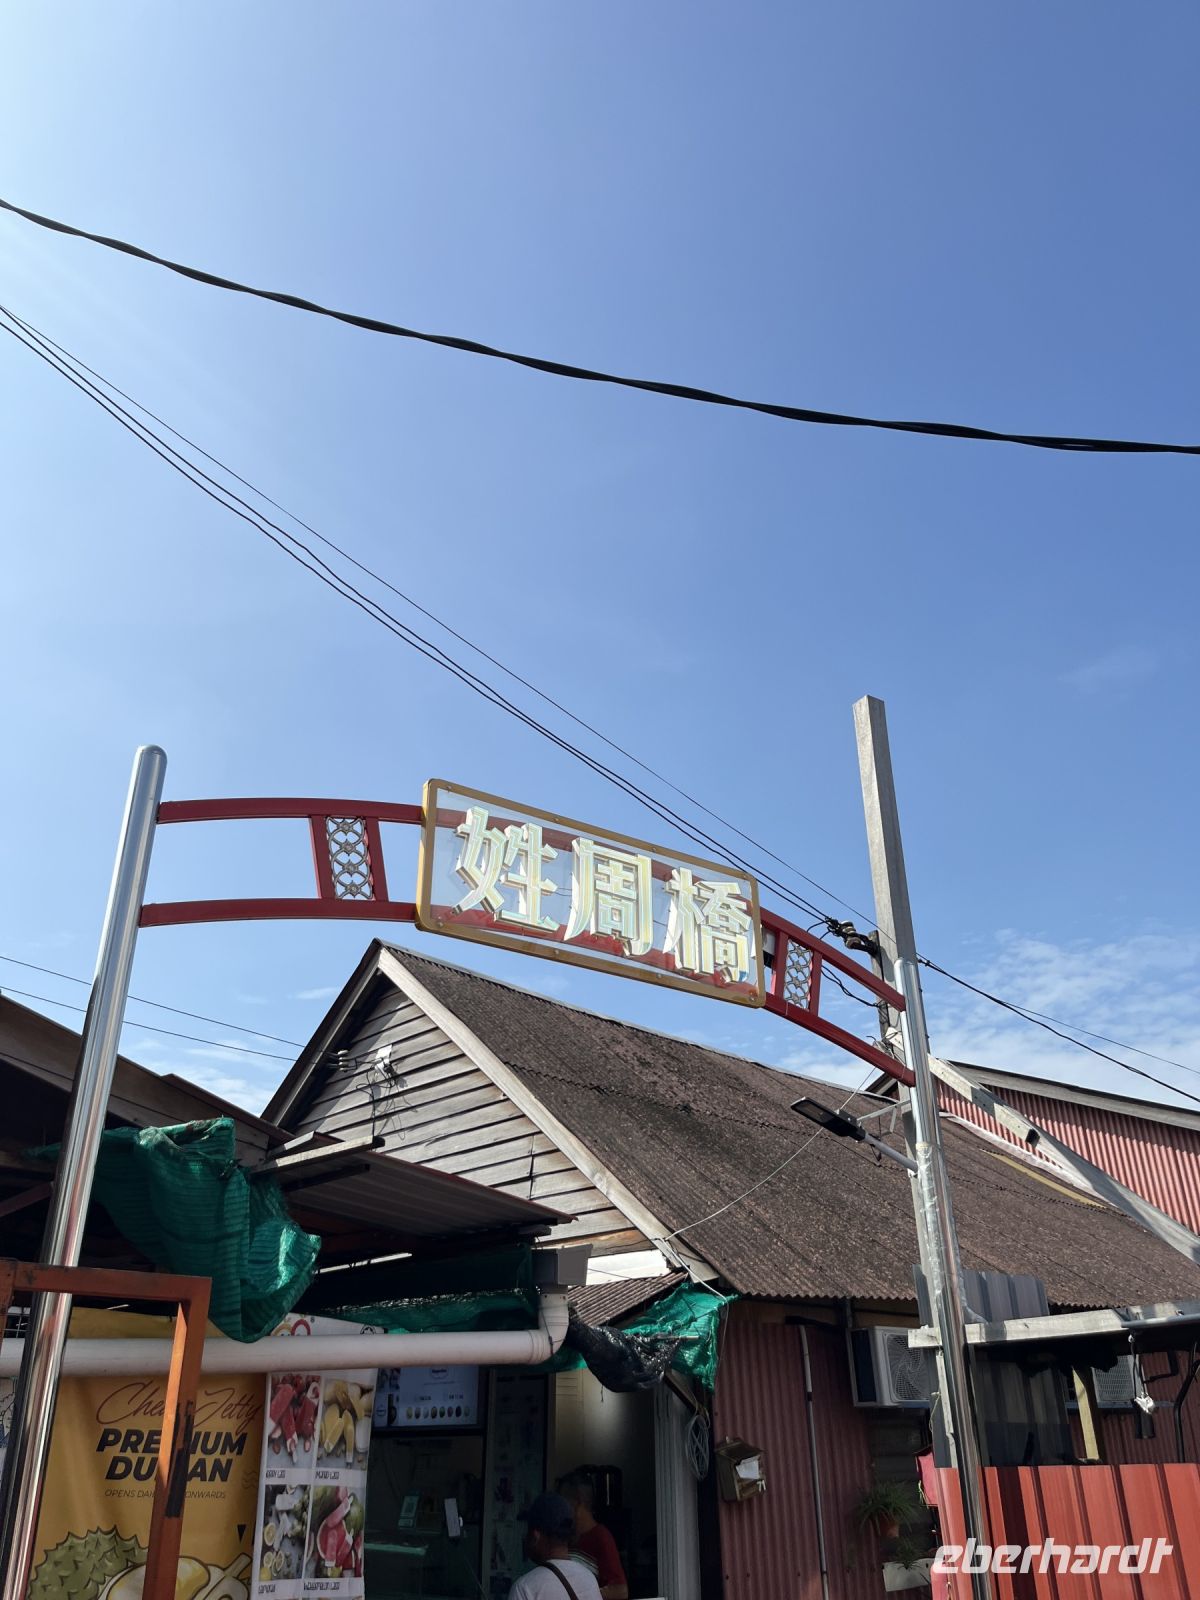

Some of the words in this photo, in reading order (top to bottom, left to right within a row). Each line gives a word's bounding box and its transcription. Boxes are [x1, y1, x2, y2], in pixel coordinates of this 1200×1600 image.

[96, 1379, 167, 1424] Che
[96, 1428, 247, 1456] PREIUM
[105, 1456, 233, 1482] DUAN
[104, 1488, 136, 1498] OPENS
